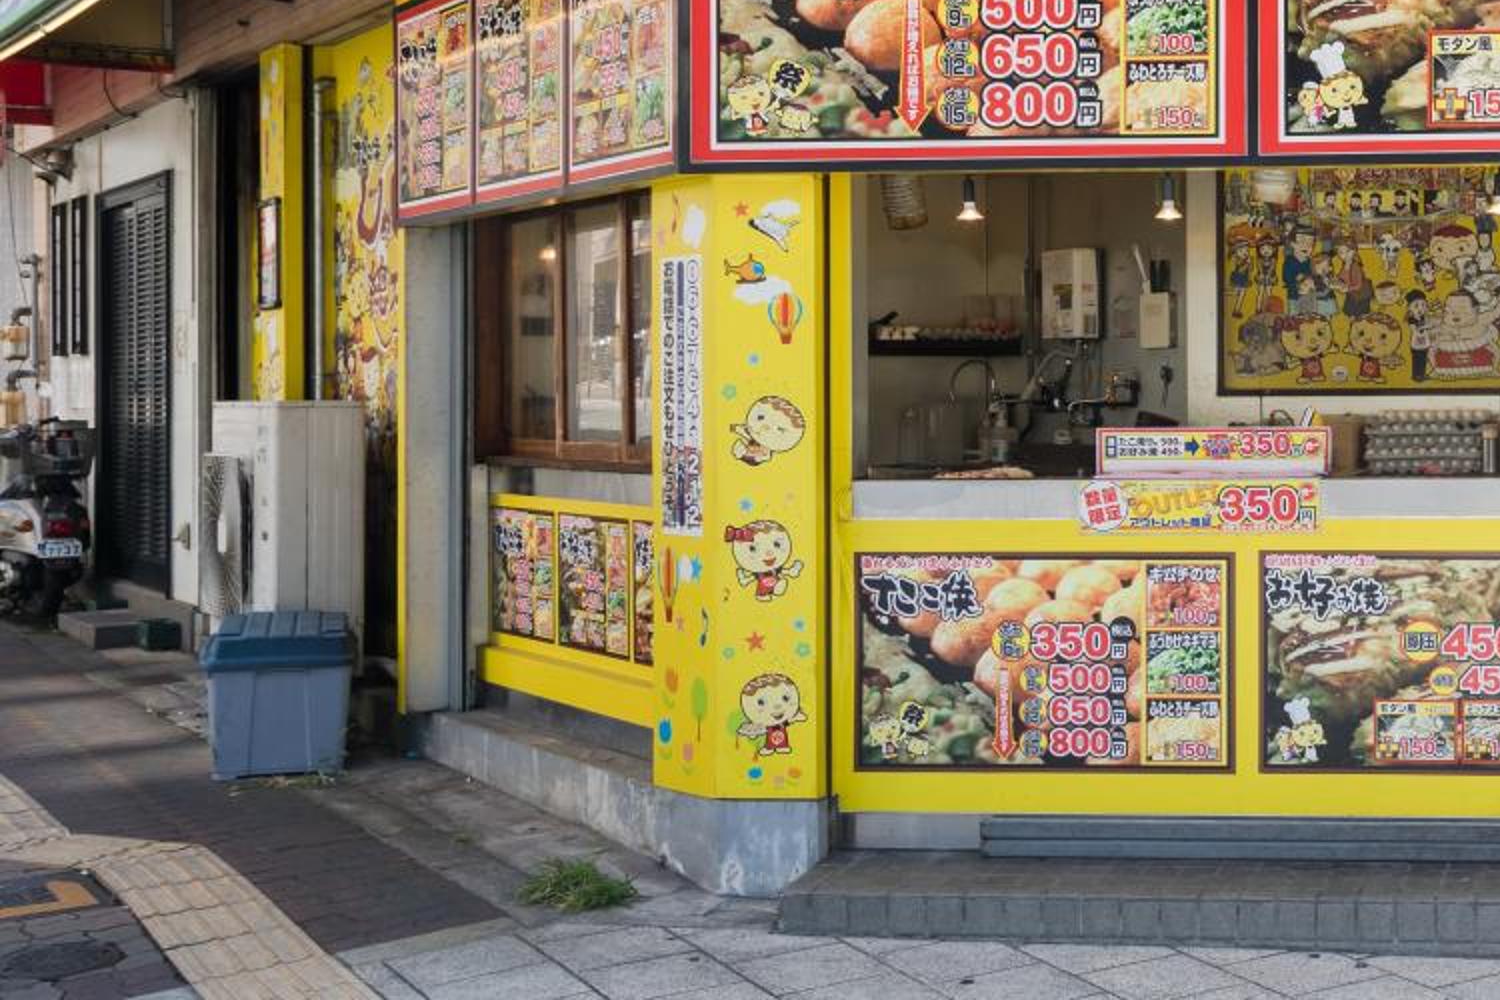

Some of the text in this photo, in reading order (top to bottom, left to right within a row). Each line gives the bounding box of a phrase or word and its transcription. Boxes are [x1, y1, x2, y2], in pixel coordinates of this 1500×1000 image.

[1078, 4, 1100, 28] 円
[1158, 33, 1195, 51] 100
[984, 35, 1100, 77] 650 円
[984, 83, 1100, 126] 800 円
[1158, 107, 1195, 126] 150
[1239, 432, 1291, 457] 350
[1221, 486, 1298, 523] 350
[1266, 569, 1388, 620] お好み焼
[1173, 607, 1208, 625] 100
[1030, 623, 1110, 660] 350
[1112, 645, 1126, 659] 円
[1050, 665, 1126, 692] 500 円
[1173, 675, 1208, 691] 100
[1050, 698, 1126, 725] 650 円
[1050, 730, 1126, 757] 800 円
[1400, 739, 1437, 756] 150
